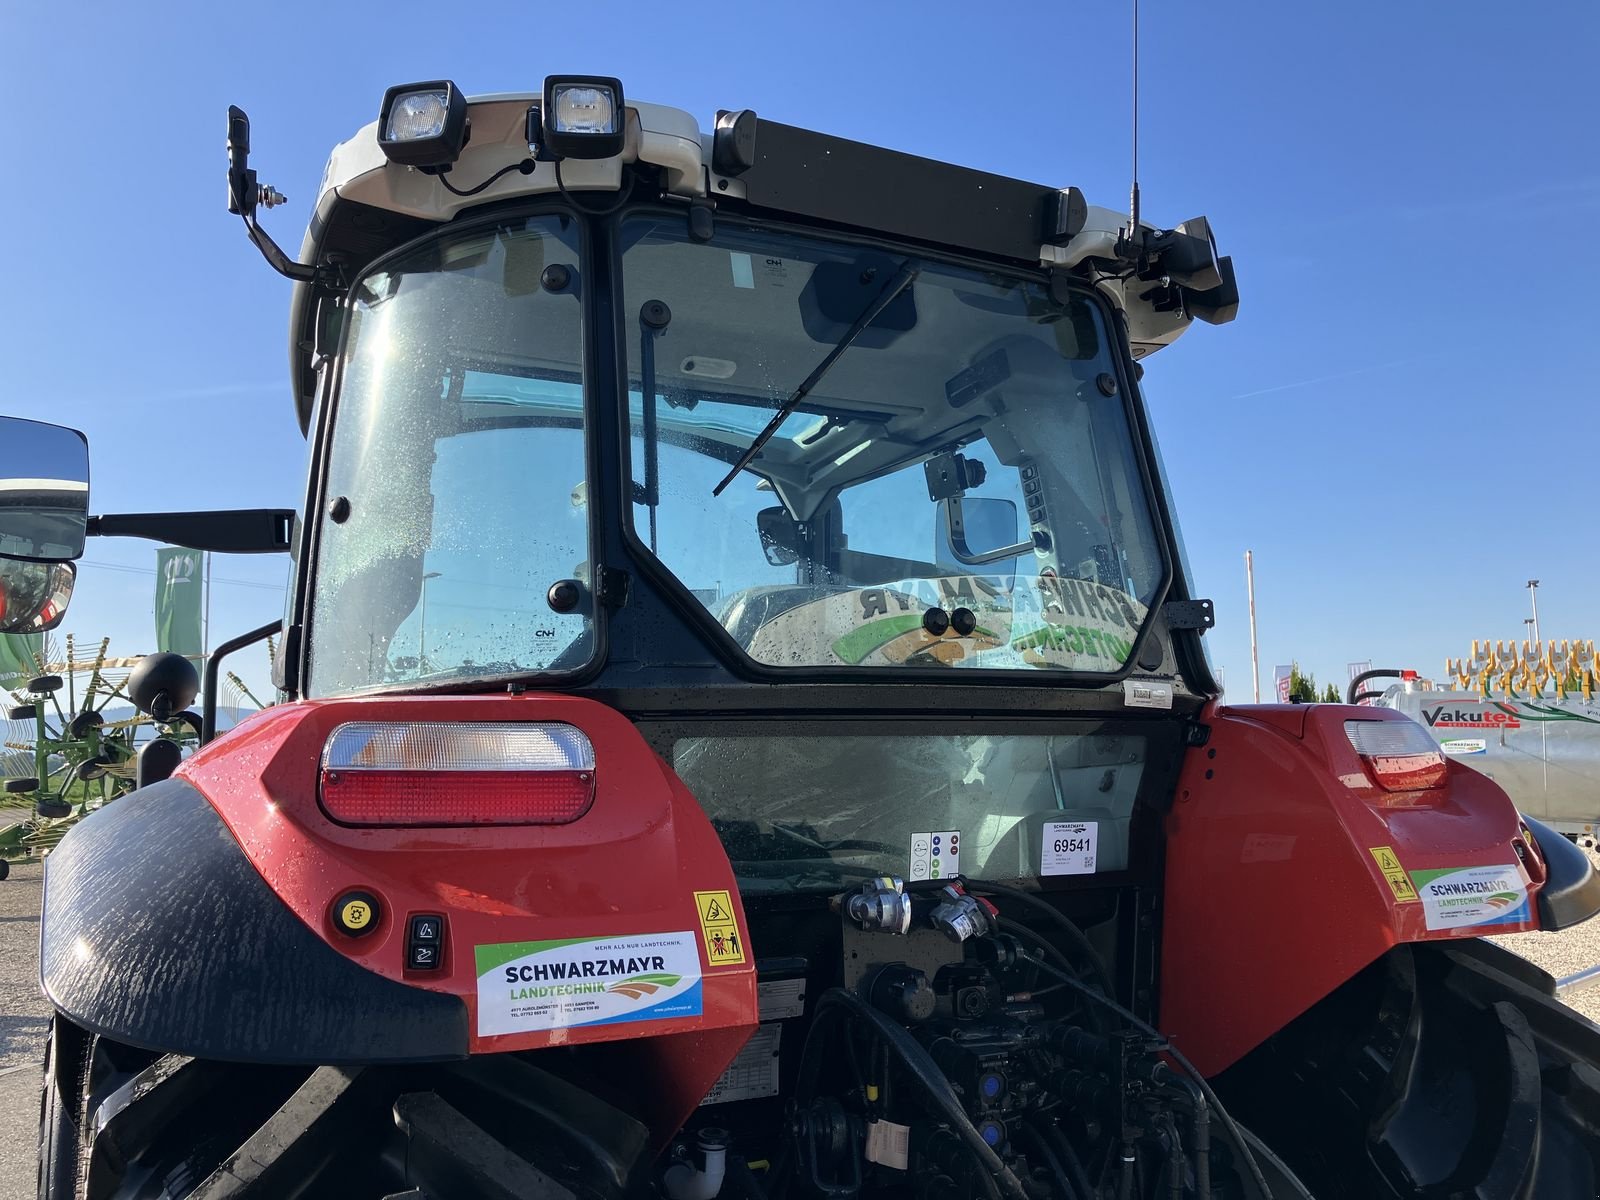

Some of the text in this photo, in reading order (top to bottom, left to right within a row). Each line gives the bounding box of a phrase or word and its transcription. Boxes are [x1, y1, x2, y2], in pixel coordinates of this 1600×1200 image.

[1421, 706, 1520, 727] Vakutec
[1054, 838, 1090, 852] 69541
[1430, 880, 1509, 896] SCHWARZMAYR
[1438, 897, 1484, 908] LANDTECHNIK
[505, 956, 665, 983] SCHWARZMAYR
[510, 982, 606, 1000] LANDTECHNIK
